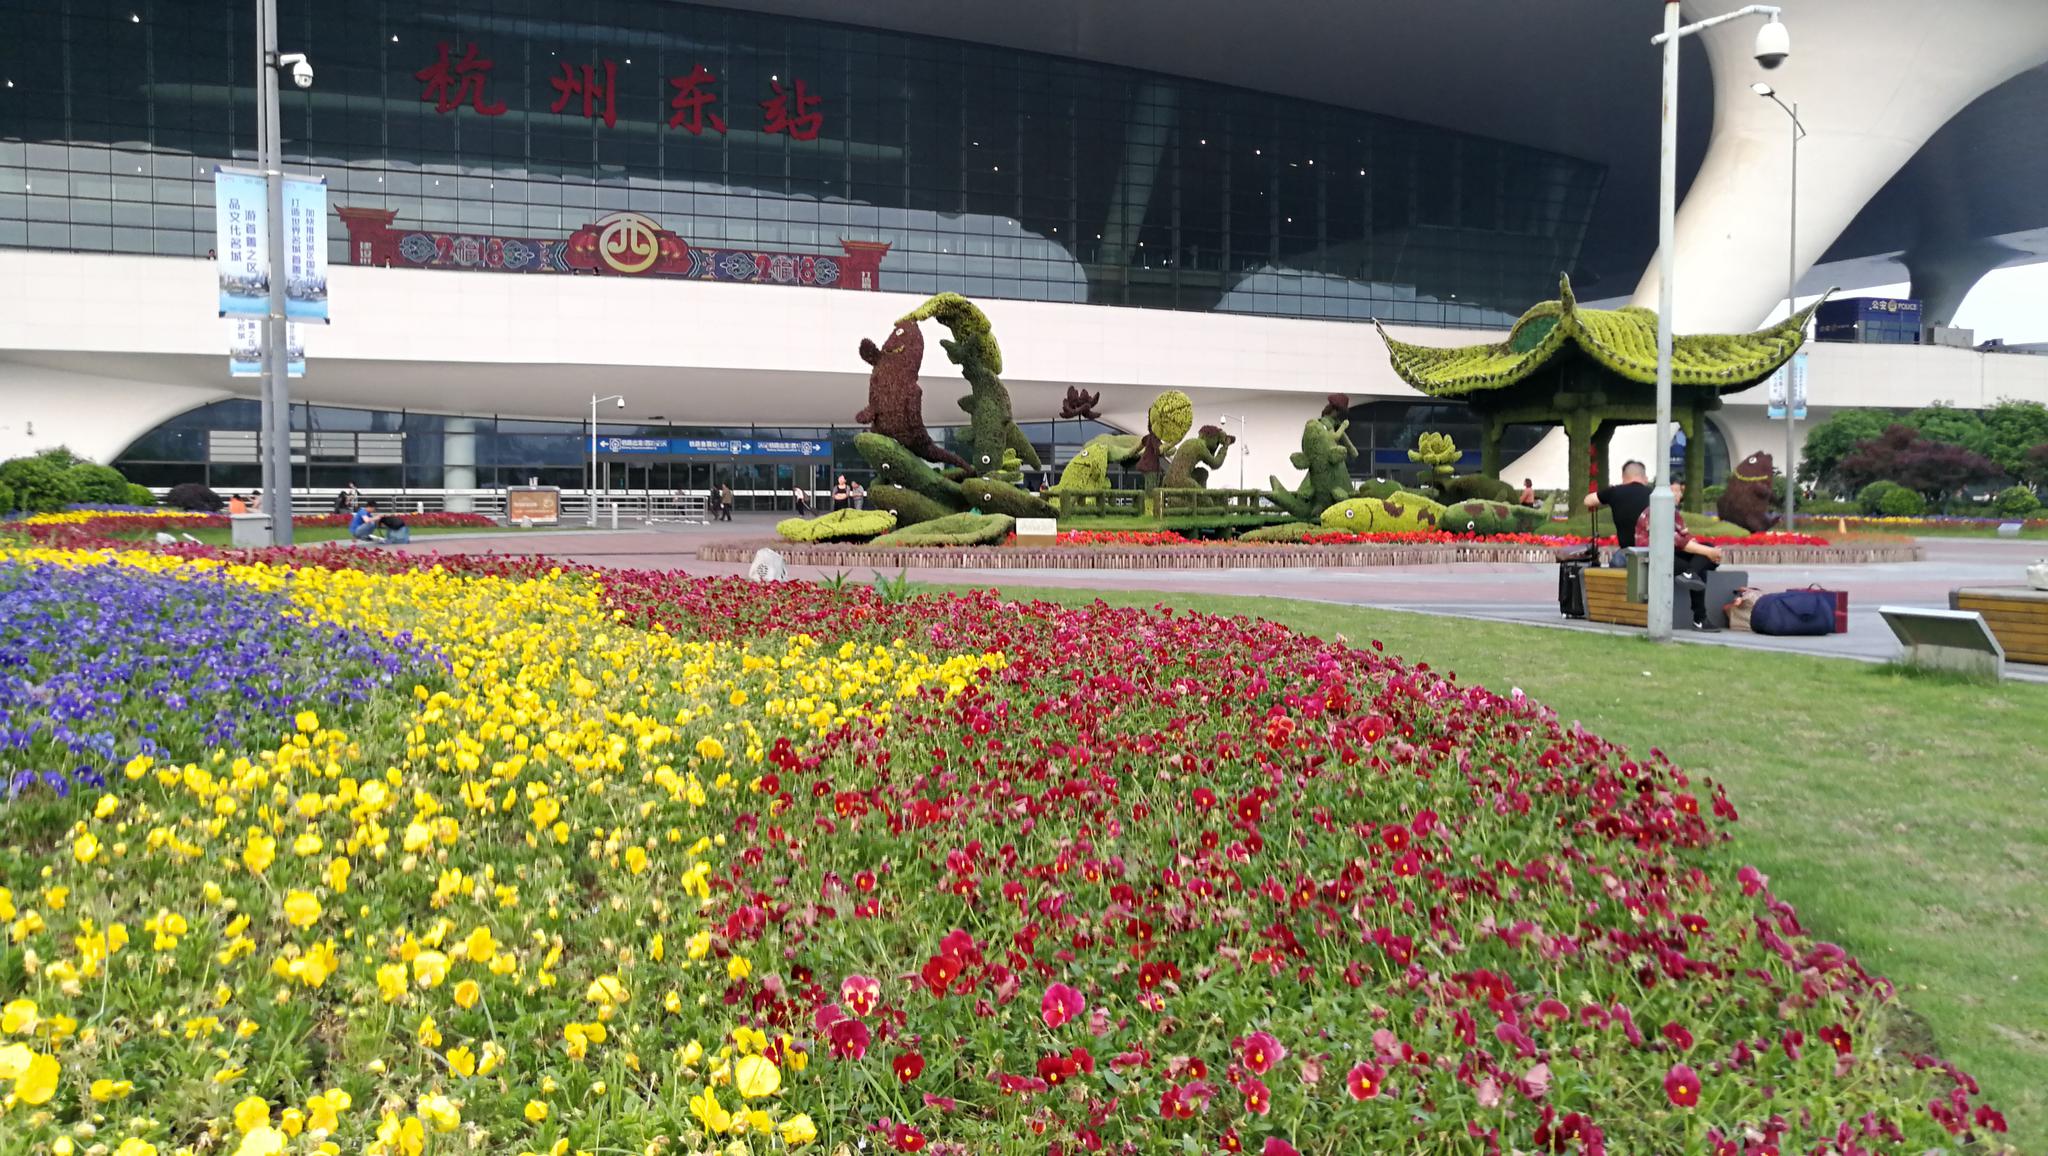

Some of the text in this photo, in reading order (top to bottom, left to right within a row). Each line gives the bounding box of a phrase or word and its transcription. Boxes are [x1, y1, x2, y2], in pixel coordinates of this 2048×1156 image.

[415, 41, 825, 141] 杭州东站
[229, 197, 242, 262] 品文化名城
[245, 209, 257, 274] 游首善之区
[1871, 300, 1888, 311] 公安
[1898, 302, 1917, 311] POLICE
